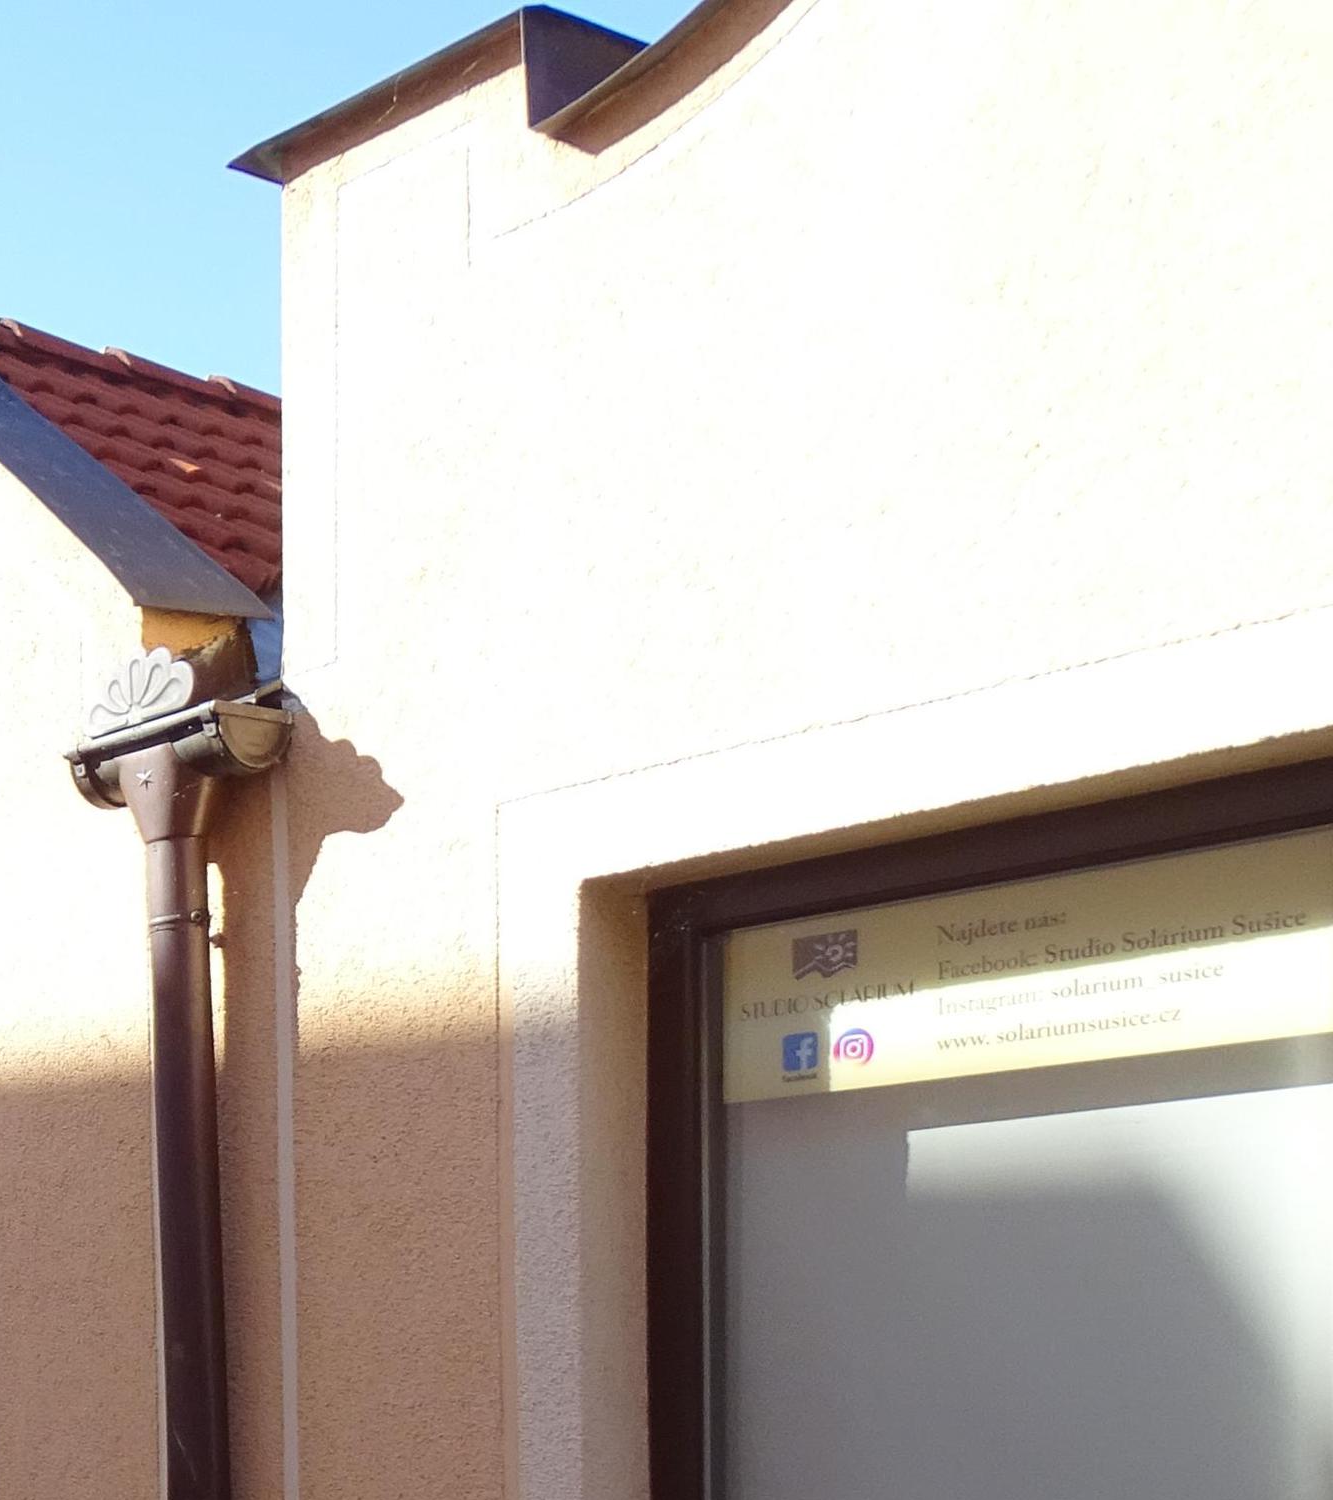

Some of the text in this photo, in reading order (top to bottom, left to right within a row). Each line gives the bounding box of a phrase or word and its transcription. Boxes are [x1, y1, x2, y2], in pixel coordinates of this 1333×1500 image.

[937, 919, 1019, 947] Najdete
[1044, 938, 1116, 964] Studio
[1232, 911, 1307, 936] Sušice
